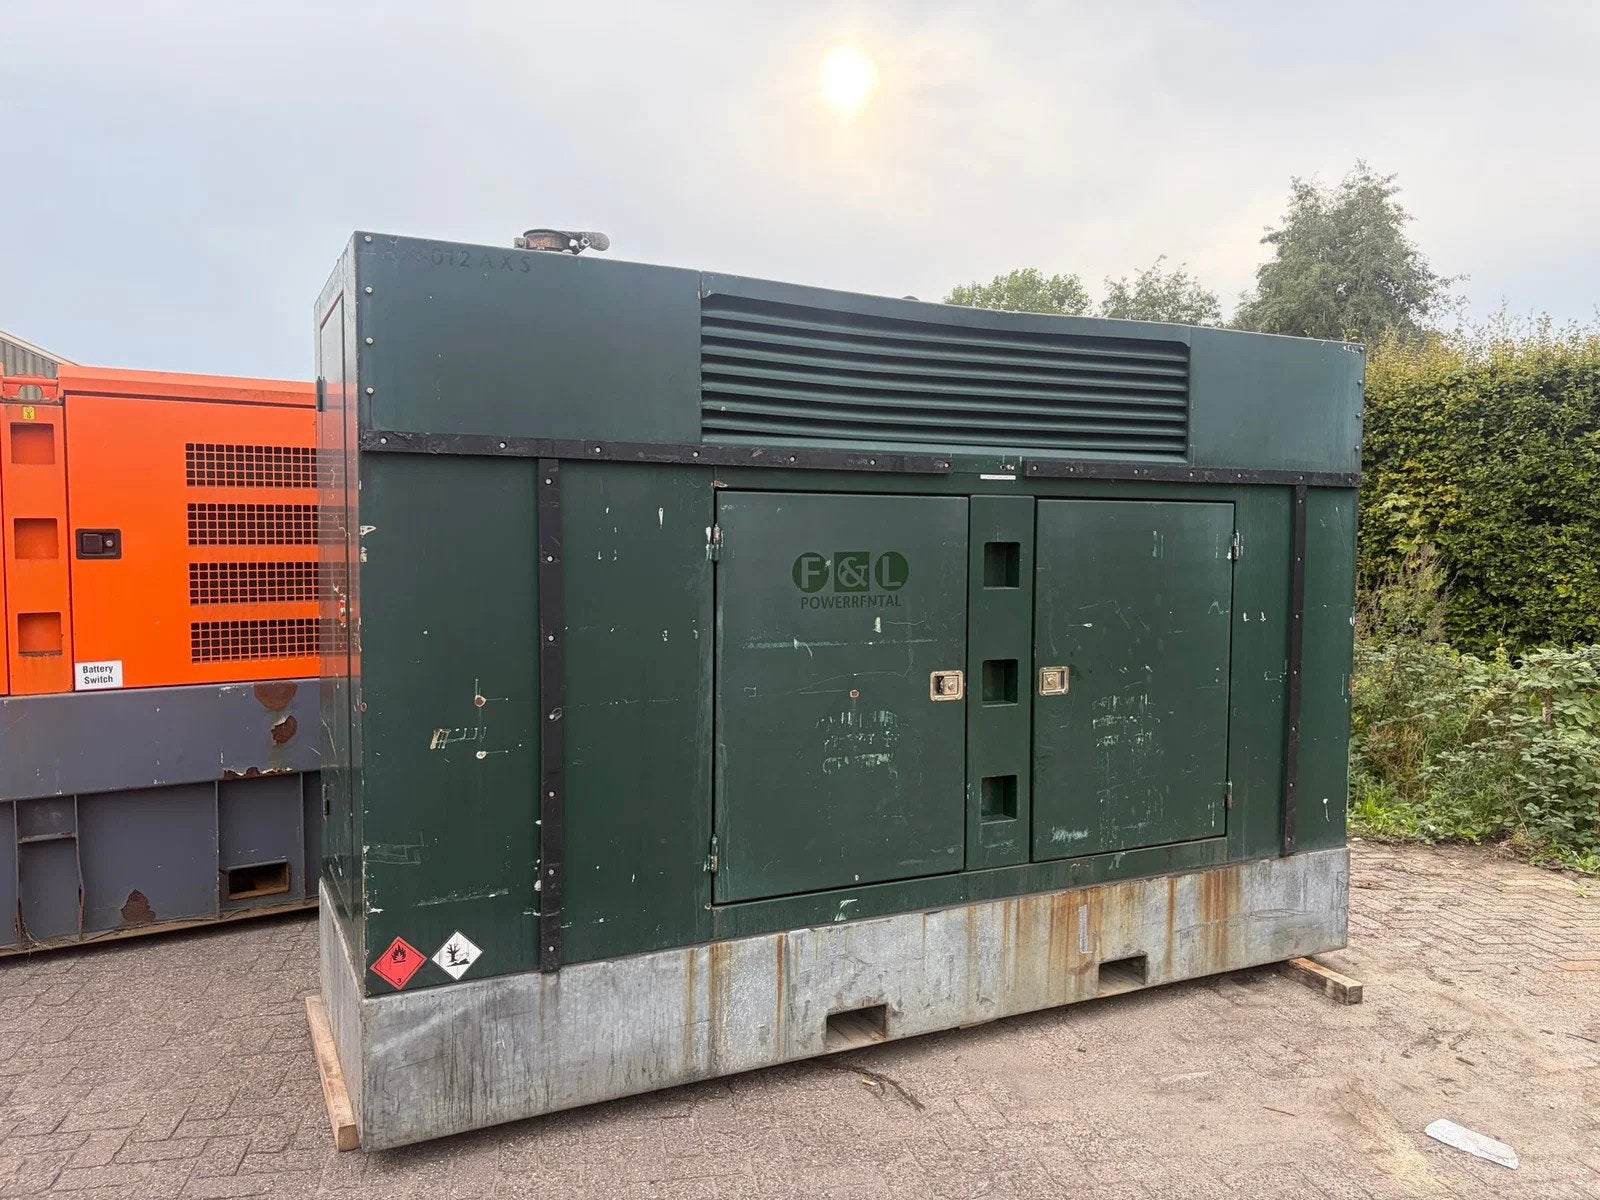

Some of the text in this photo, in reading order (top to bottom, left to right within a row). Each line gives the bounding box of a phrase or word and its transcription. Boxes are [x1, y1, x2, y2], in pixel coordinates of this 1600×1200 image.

[797, 553, 905, 591] F&L
[82, 665, 114, 674] Battery
[84, 675, 114, 685] Switch
